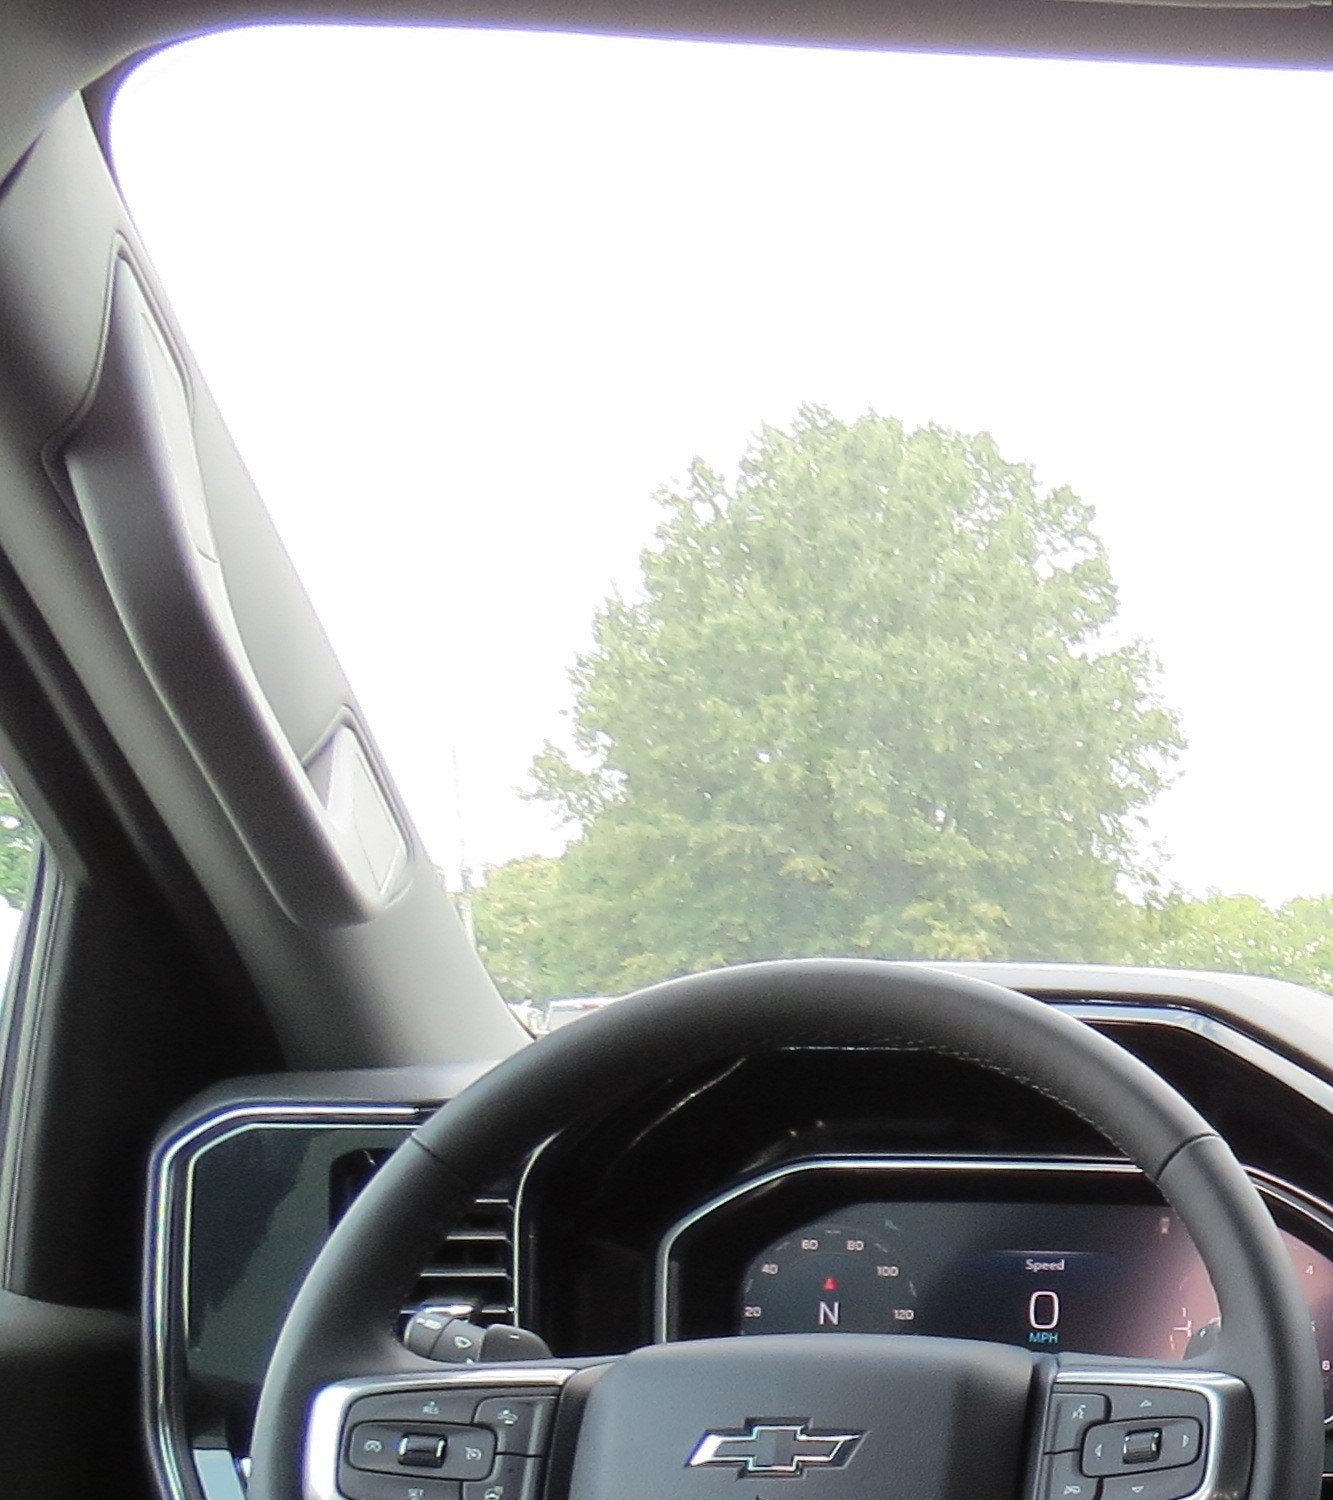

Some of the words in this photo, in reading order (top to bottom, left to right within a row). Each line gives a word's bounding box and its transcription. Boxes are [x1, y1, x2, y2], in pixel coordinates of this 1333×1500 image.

[801, 1239, 819, 1251] 60
[846, 1240, 865, 1251] 80
[761, 1263, 779, 1275] 40
[876, 1266, 899, 1277] 100
[1025, 1258, 1065, 1273] Speed
[744, 1306, 762, 1318] 20
[818, 1301, 840, 1325] N
[893, 1309, 915, 1321] 120
[1029, 1290, 1060, 1330] 0
[1028, 1331, 1059, 1344] MPH
